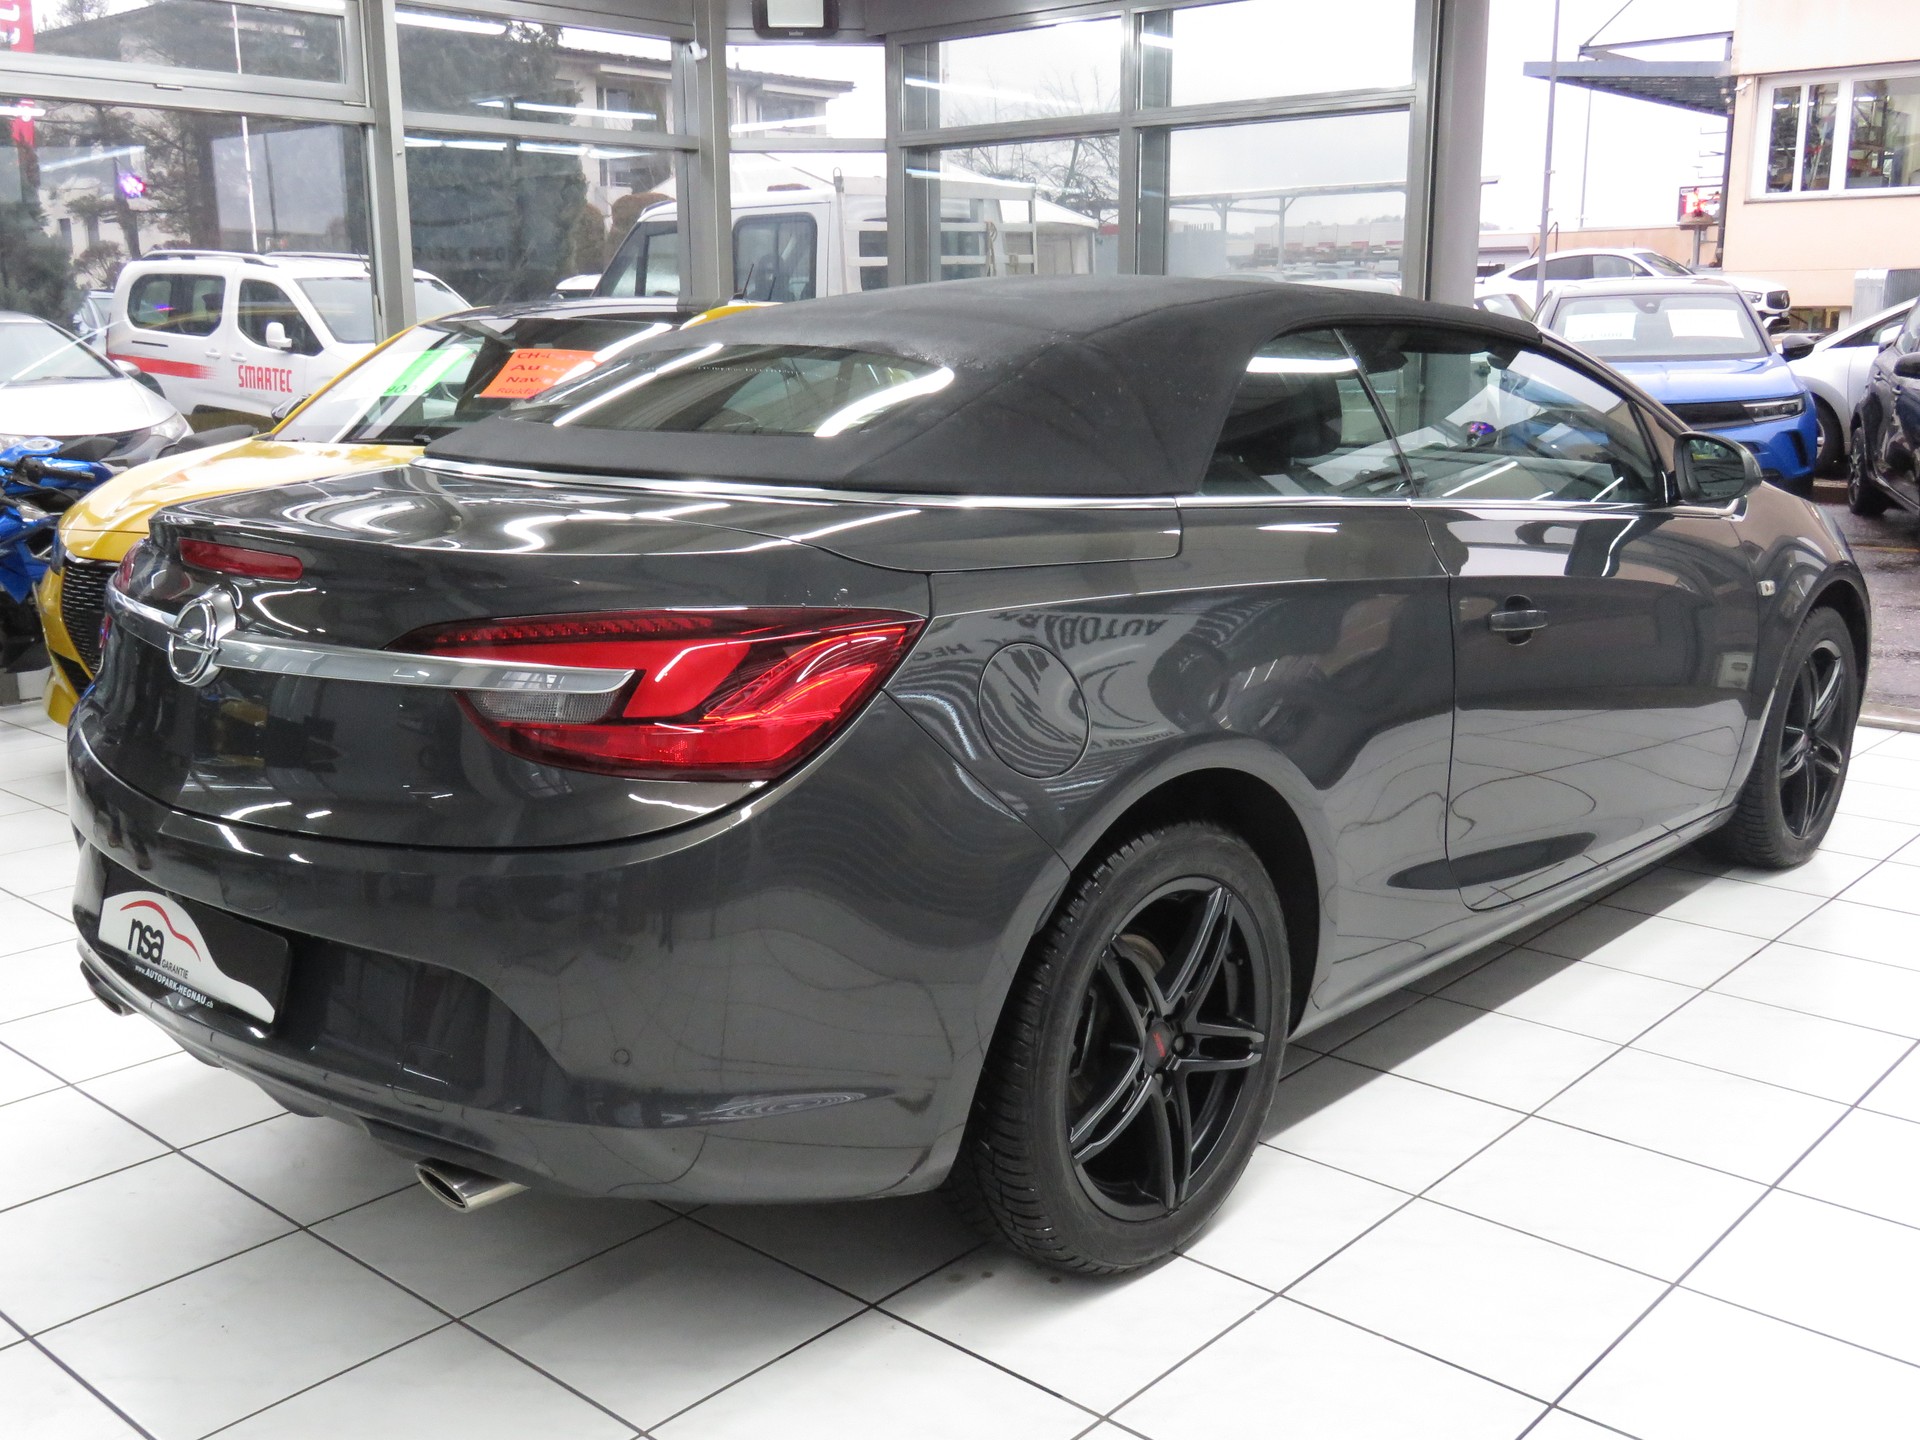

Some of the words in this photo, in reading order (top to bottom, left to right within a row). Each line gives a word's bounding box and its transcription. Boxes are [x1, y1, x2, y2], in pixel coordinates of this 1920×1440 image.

[238, 365, 293, 393] SMARTEC
[128, 918, 165, 966] nsa
[135, 964, 214, 1009] www.AUTOPARK-HEGNAU.ch
[161, 959, 190, 979] GARANTIE
